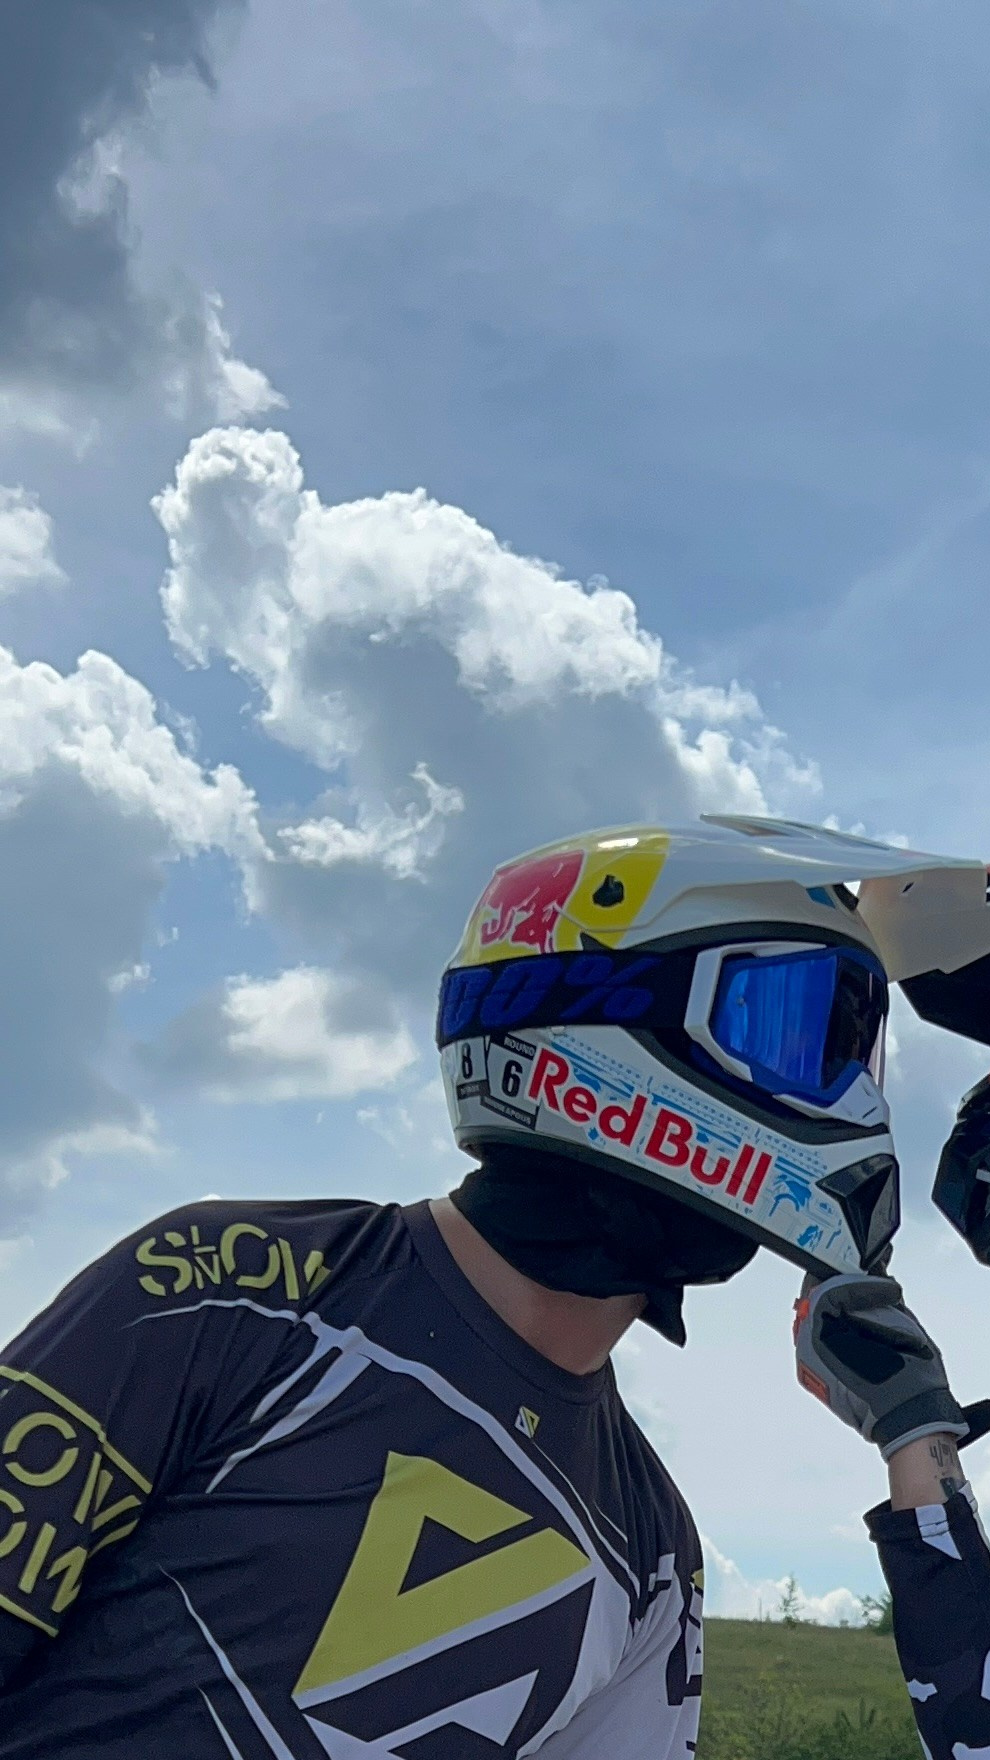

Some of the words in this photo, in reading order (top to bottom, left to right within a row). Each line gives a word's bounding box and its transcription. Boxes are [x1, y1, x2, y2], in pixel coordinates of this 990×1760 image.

[461, 1042, 473, 1079] 8
[501, 1059, 523, 1098] 6
[529, 1047, 648, 1148] Red
[644, 1107, 773, 1206] Bull
